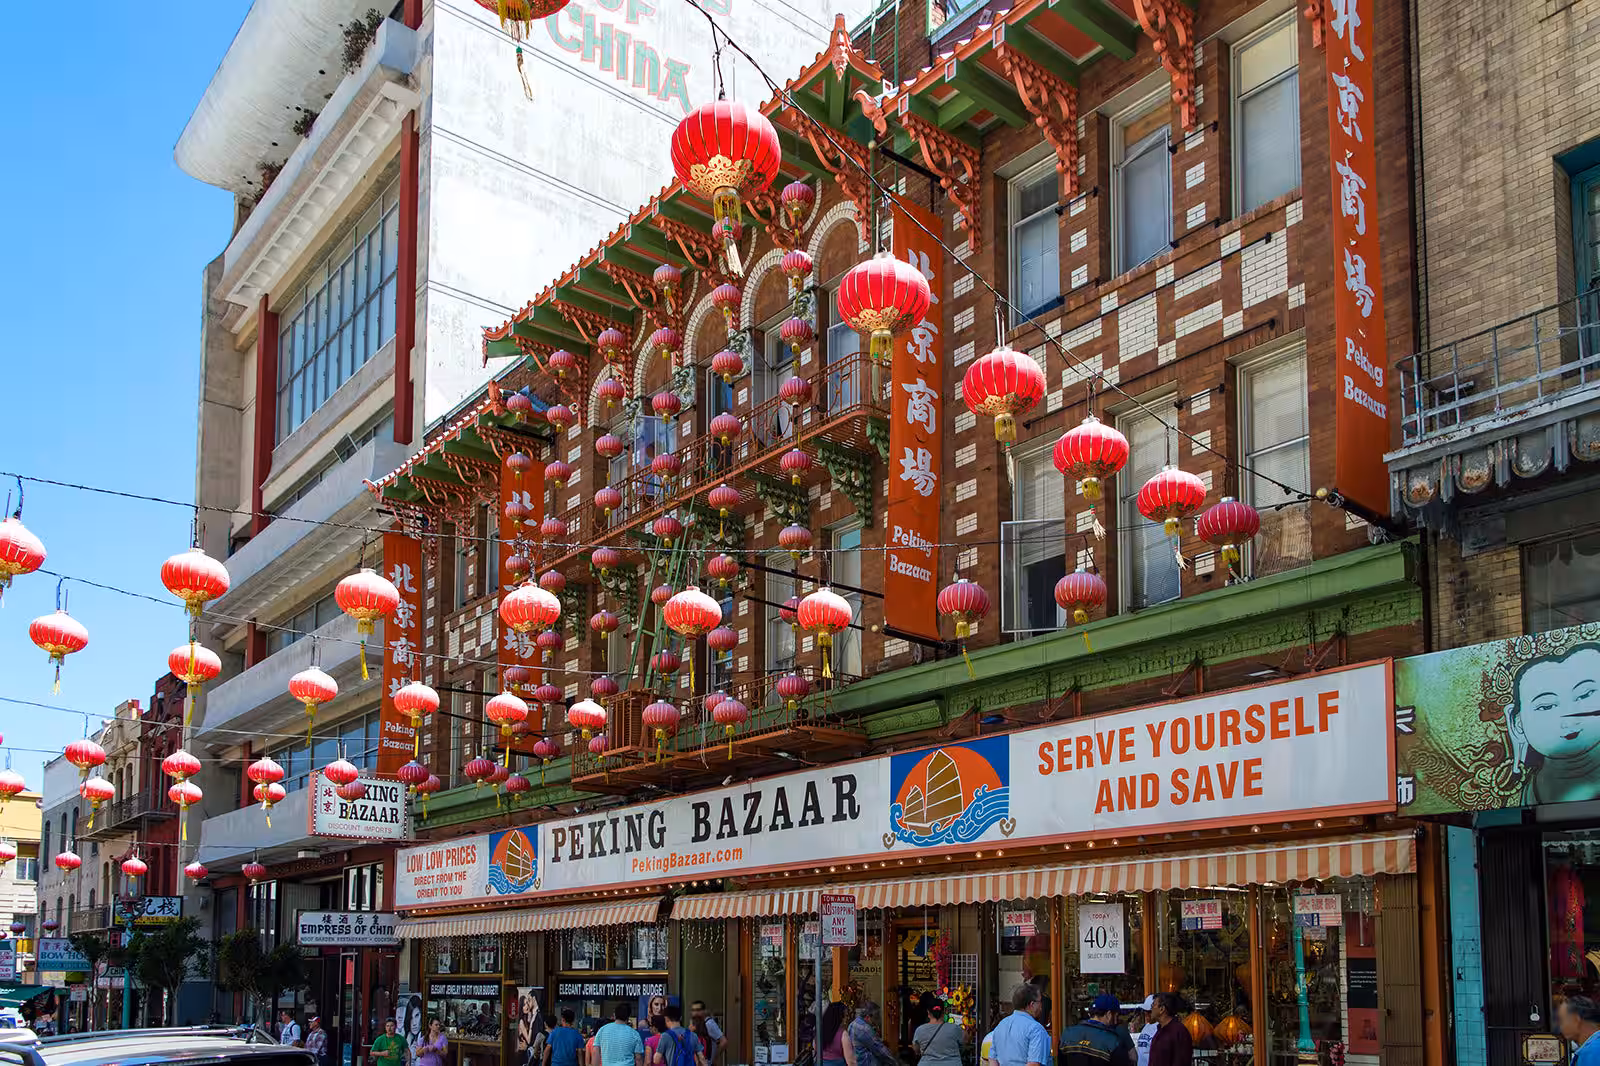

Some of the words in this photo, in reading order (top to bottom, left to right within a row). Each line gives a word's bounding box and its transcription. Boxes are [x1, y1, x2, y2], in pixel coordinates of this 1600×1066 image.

[545, 3, 693, 115] CHINA
[1345, 336, 1384, 388] Peking
[1343, 374, 1387, 419] Bazaar
[892, 525, 932, 558] Peking
[890, 554, 932, 582] Bazaar
[384, 721, 415, 737] Peking
[1038, 726, 1136, 776] SERVE
[1146, 690, 1340, 757] YOURSELF
[383, 737, 414, 751] Bazaar
[361, 784, 399, 803] KING
[1094, 772, 1160, 814] AND
[1170, 757, 1263, 805] SAVE
[323, 787, 333, 812] 北京
[339, 802, 399, 823] BAZAAR
[551, 810, 667, 863] PEKING
[691, 773, 861, 843] BAZAAR
[328, 822, 360, 832] DISCOUNT
[363, 824, 393, 834] IMPORTS
[406, 854, 424, 873] LOW
[426, 850, 444, 870] LOW
[445, 844, 477, 867] PRICES
[631, 847, 743, 873] PekingBazaar.com
[414, 874, 435, 886] DIRECT
[436, 872, 452, 884] FROM
[454, 871, 466, 881] THE
[416, 887, 438, 899] ORIENT
[440, 887, 449, 896] TO
[450, 885, 463, 895] YOU
[822, 902, 831, 915] NO
[831, 905, 854, 915] STOPPING
[300, 924, 351, 936] EMPRESS
[354, 924, 368, 936] OF
[832, 917, 846, 926] ANY
[831, 927, 847, 936] TIME
[1108, 940, 1119, 949] OFF
[40, 951, 65, 960] BOW
[431, 984, 446, 995] ELEGANT
[446, 984, 461, 995] JEWELRY
[461, 984, 466, 995] TO
[473, 984, 482, 995] YOUR
[559, 983, 581, 995] ELEGANT
[582, 983, 606, 996] JEWELRY
[607, 984, 615, 995] TO
[615, 984, 624, 996] FIT
[625, 984, 641, 996] YOUR
